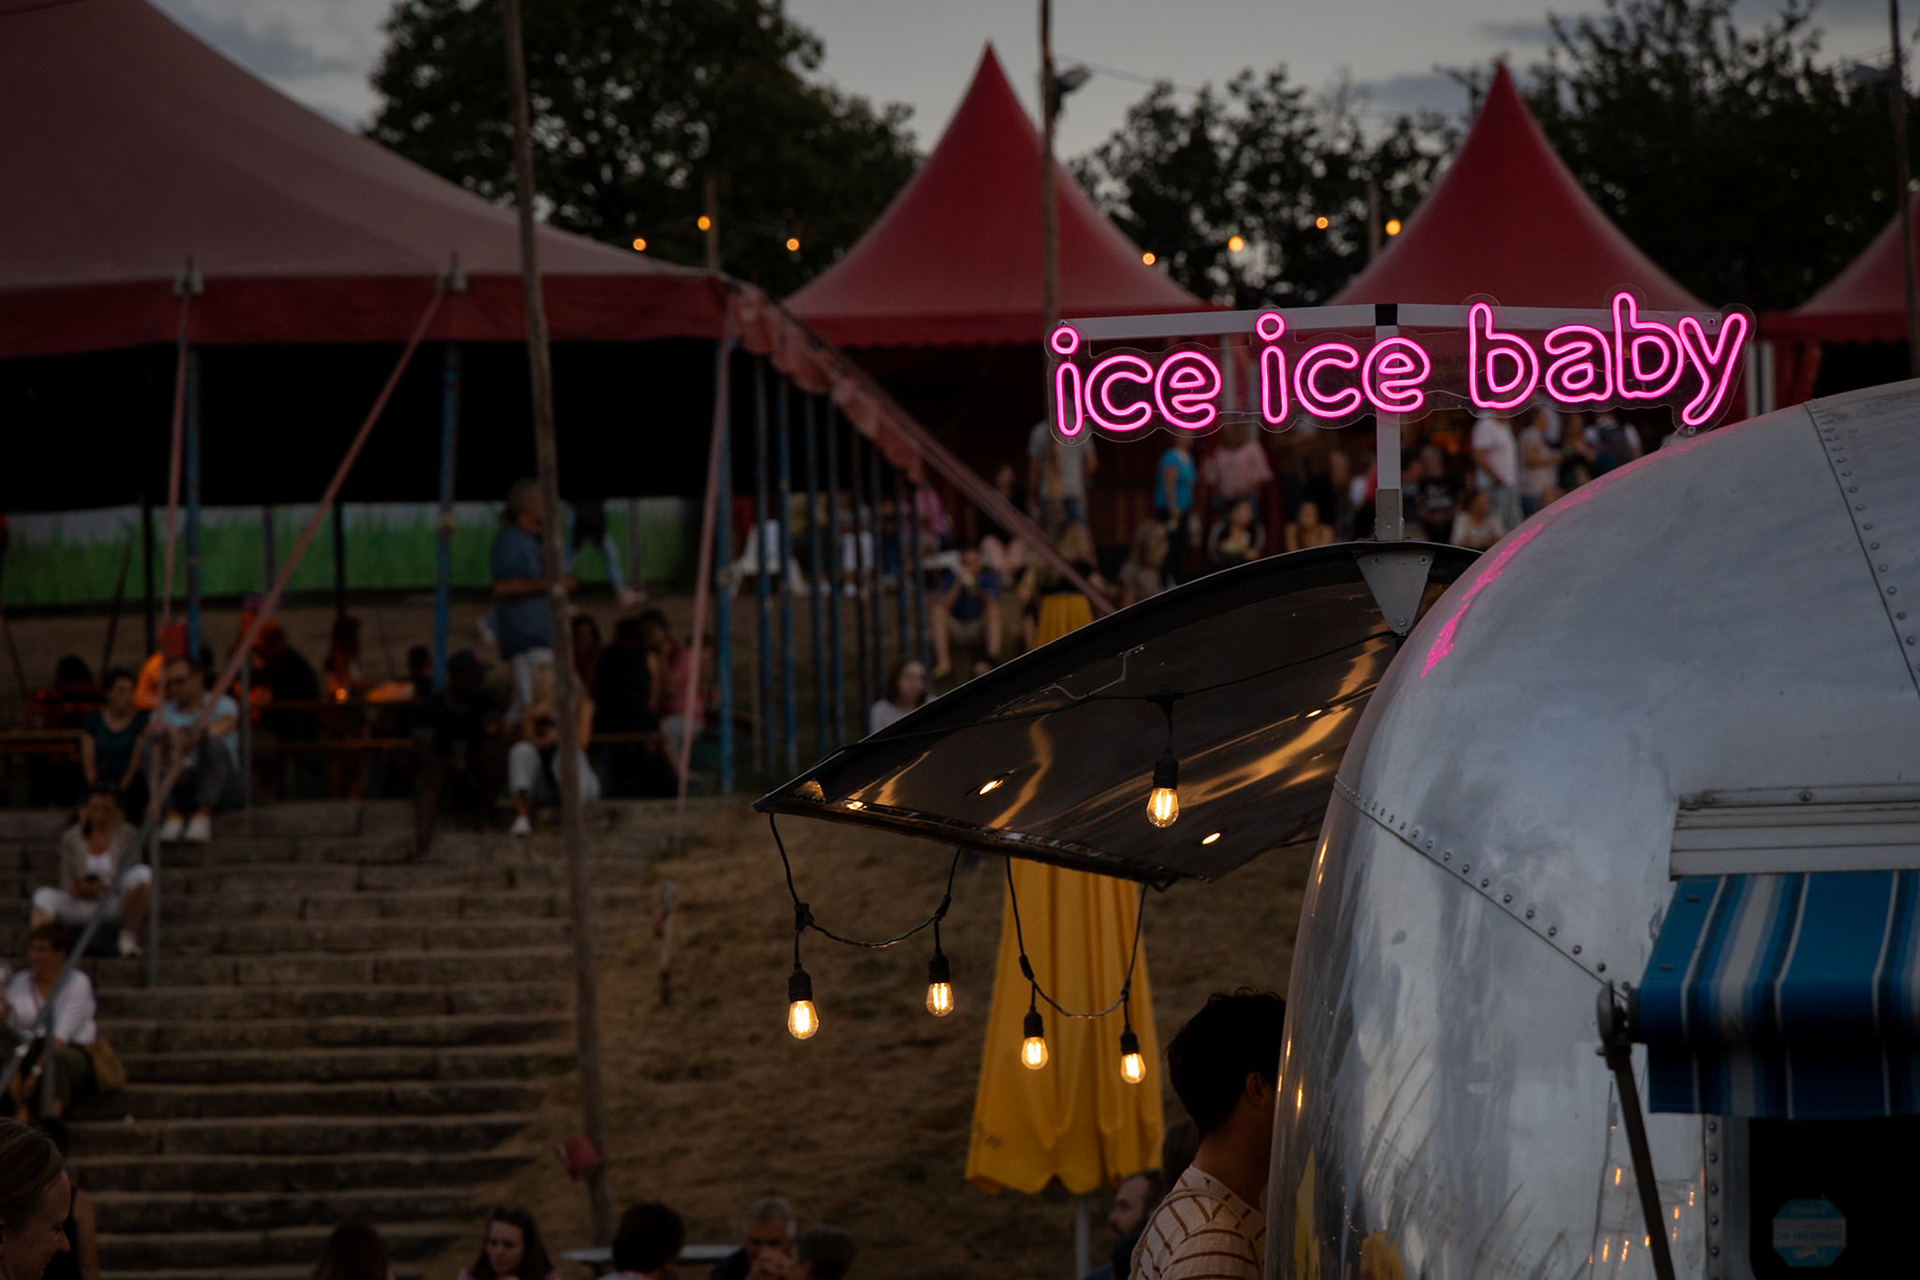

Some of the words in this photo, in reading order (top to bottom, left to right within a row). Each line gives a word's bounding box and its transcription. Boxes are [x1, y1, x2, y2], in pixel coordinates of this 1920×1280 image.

[1050, 325, 1222, 437] ice
[1255, 312, 1431, 425] ice
[1468, 291, 1748, 427] baby
